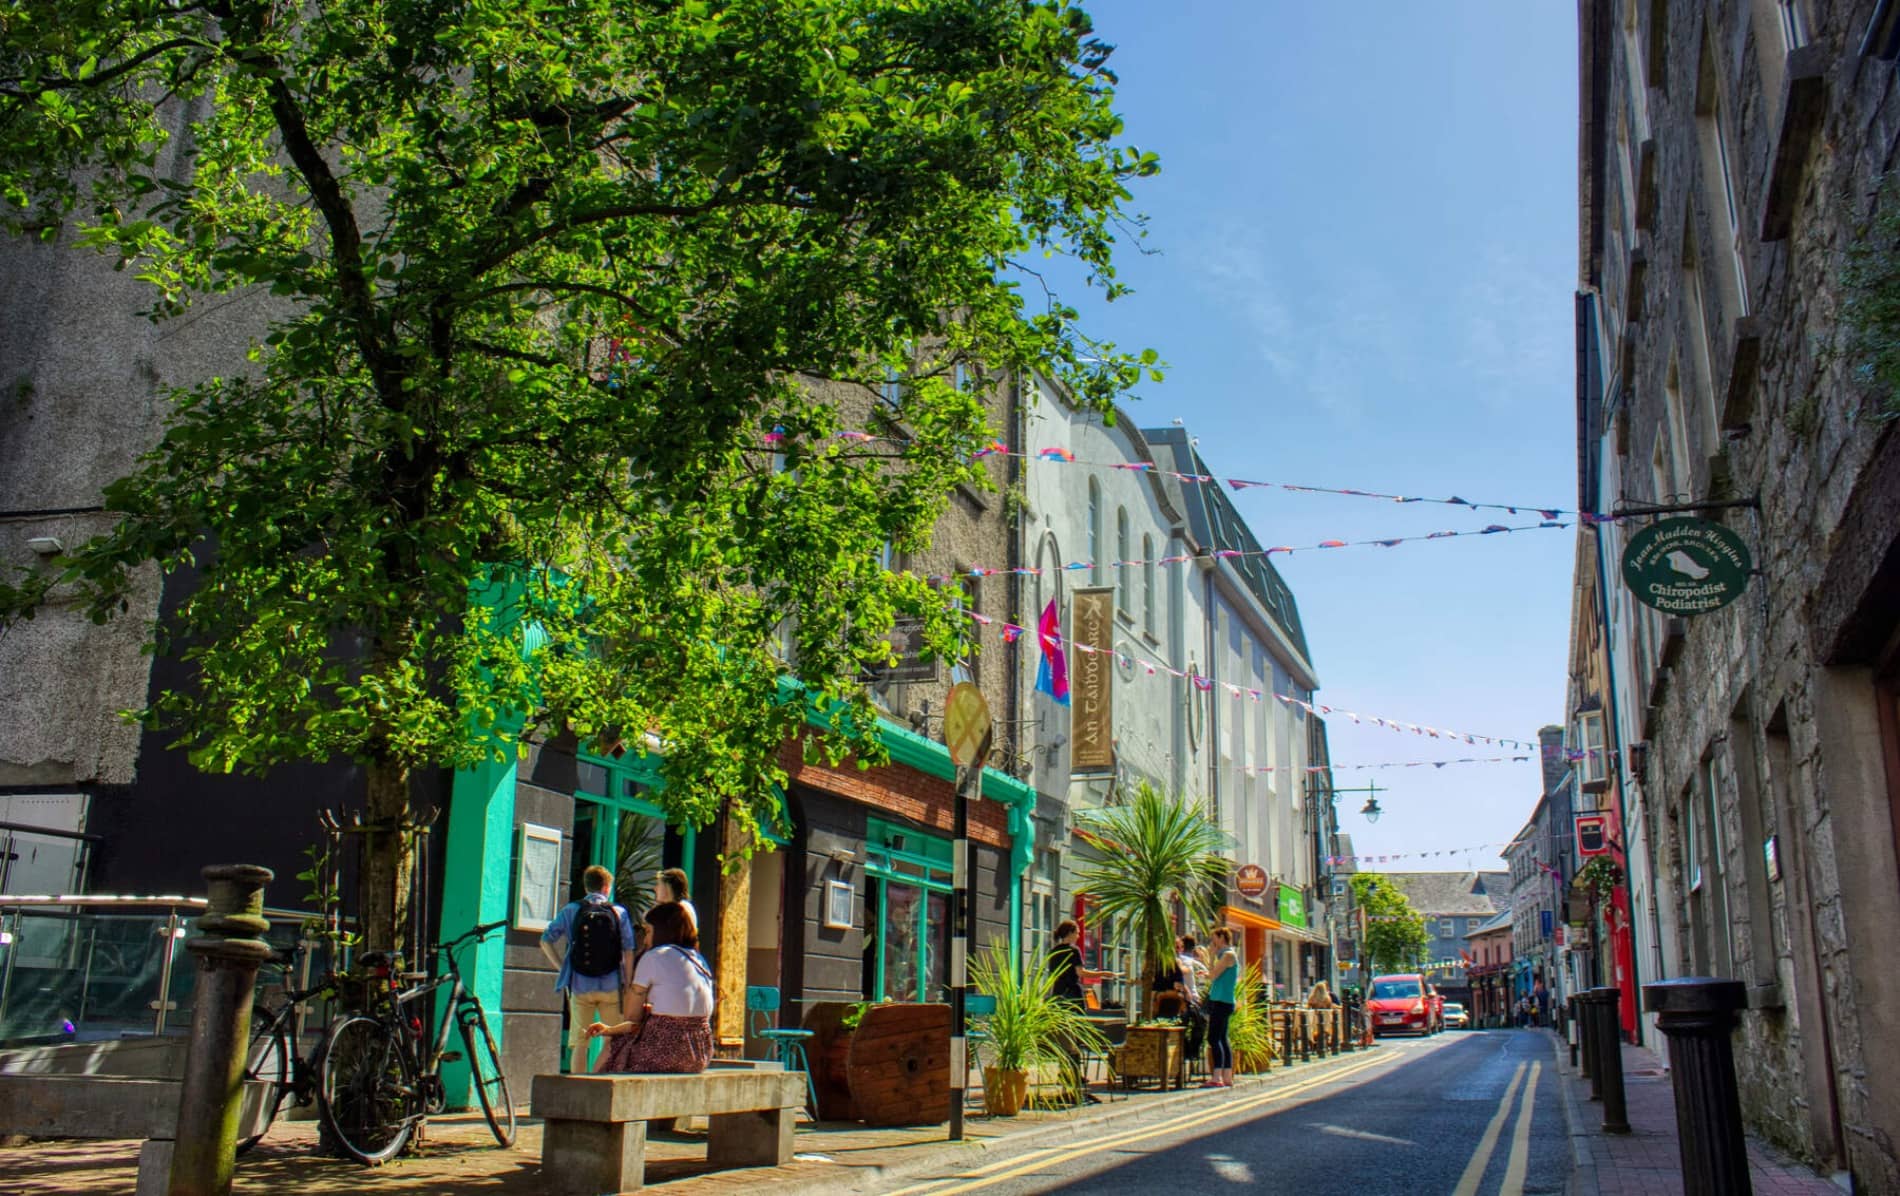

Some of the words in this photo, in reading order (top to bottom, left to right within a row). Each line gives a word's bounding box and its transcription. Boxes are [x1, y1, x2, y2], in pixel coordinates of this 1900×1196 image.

[1704, 530, 1743, 568] Higgins
[1649, 581, 1727, 599] Chiropodist
[1655, 595, 1721, 610] Podiatrist
